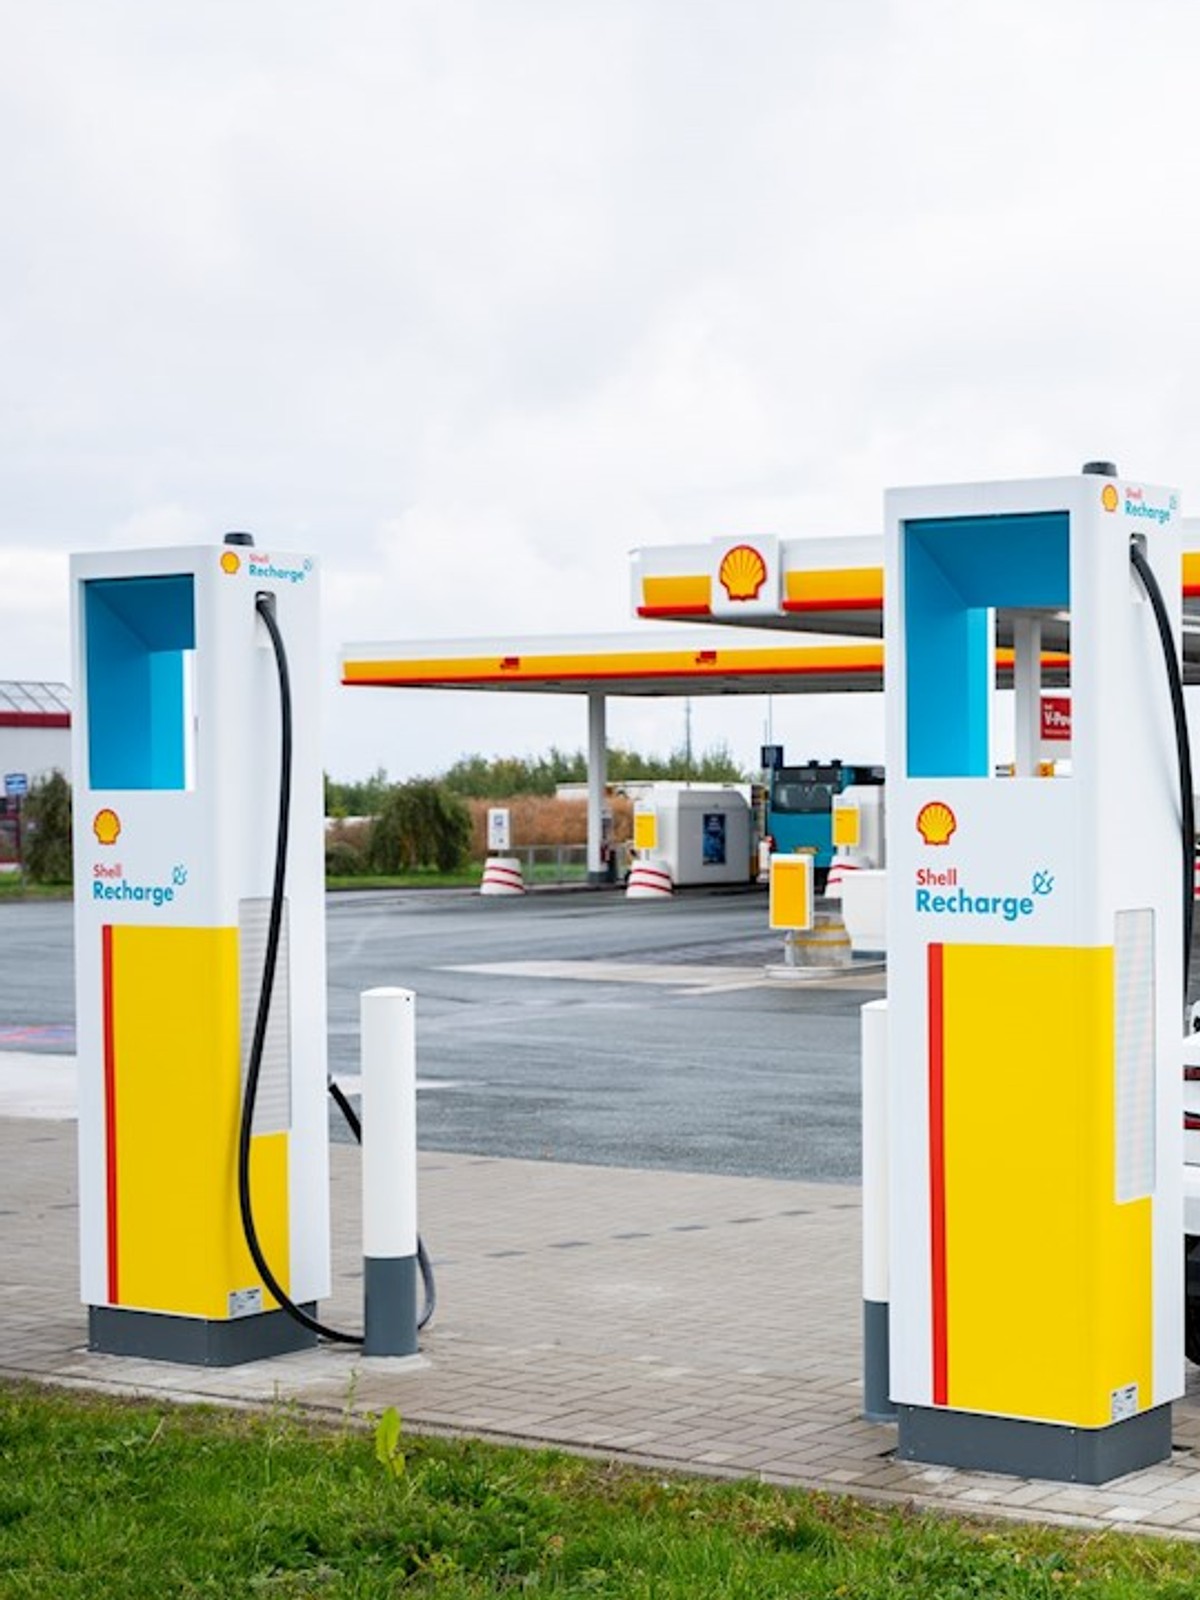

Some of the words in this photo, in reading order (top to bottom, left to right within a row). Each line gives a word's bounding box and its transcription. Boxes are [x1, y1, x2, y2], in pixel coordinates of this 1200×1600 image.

[1125, 500, 1170, 524] Recharge
[249, 564, 304, 582] Recharge
[93, 863, 122, 878] Shell
[917, 868, 957, 886] Shell
[93, 880, 174, 906] Recharge
[916, 887, 1033, 921] Recharge
